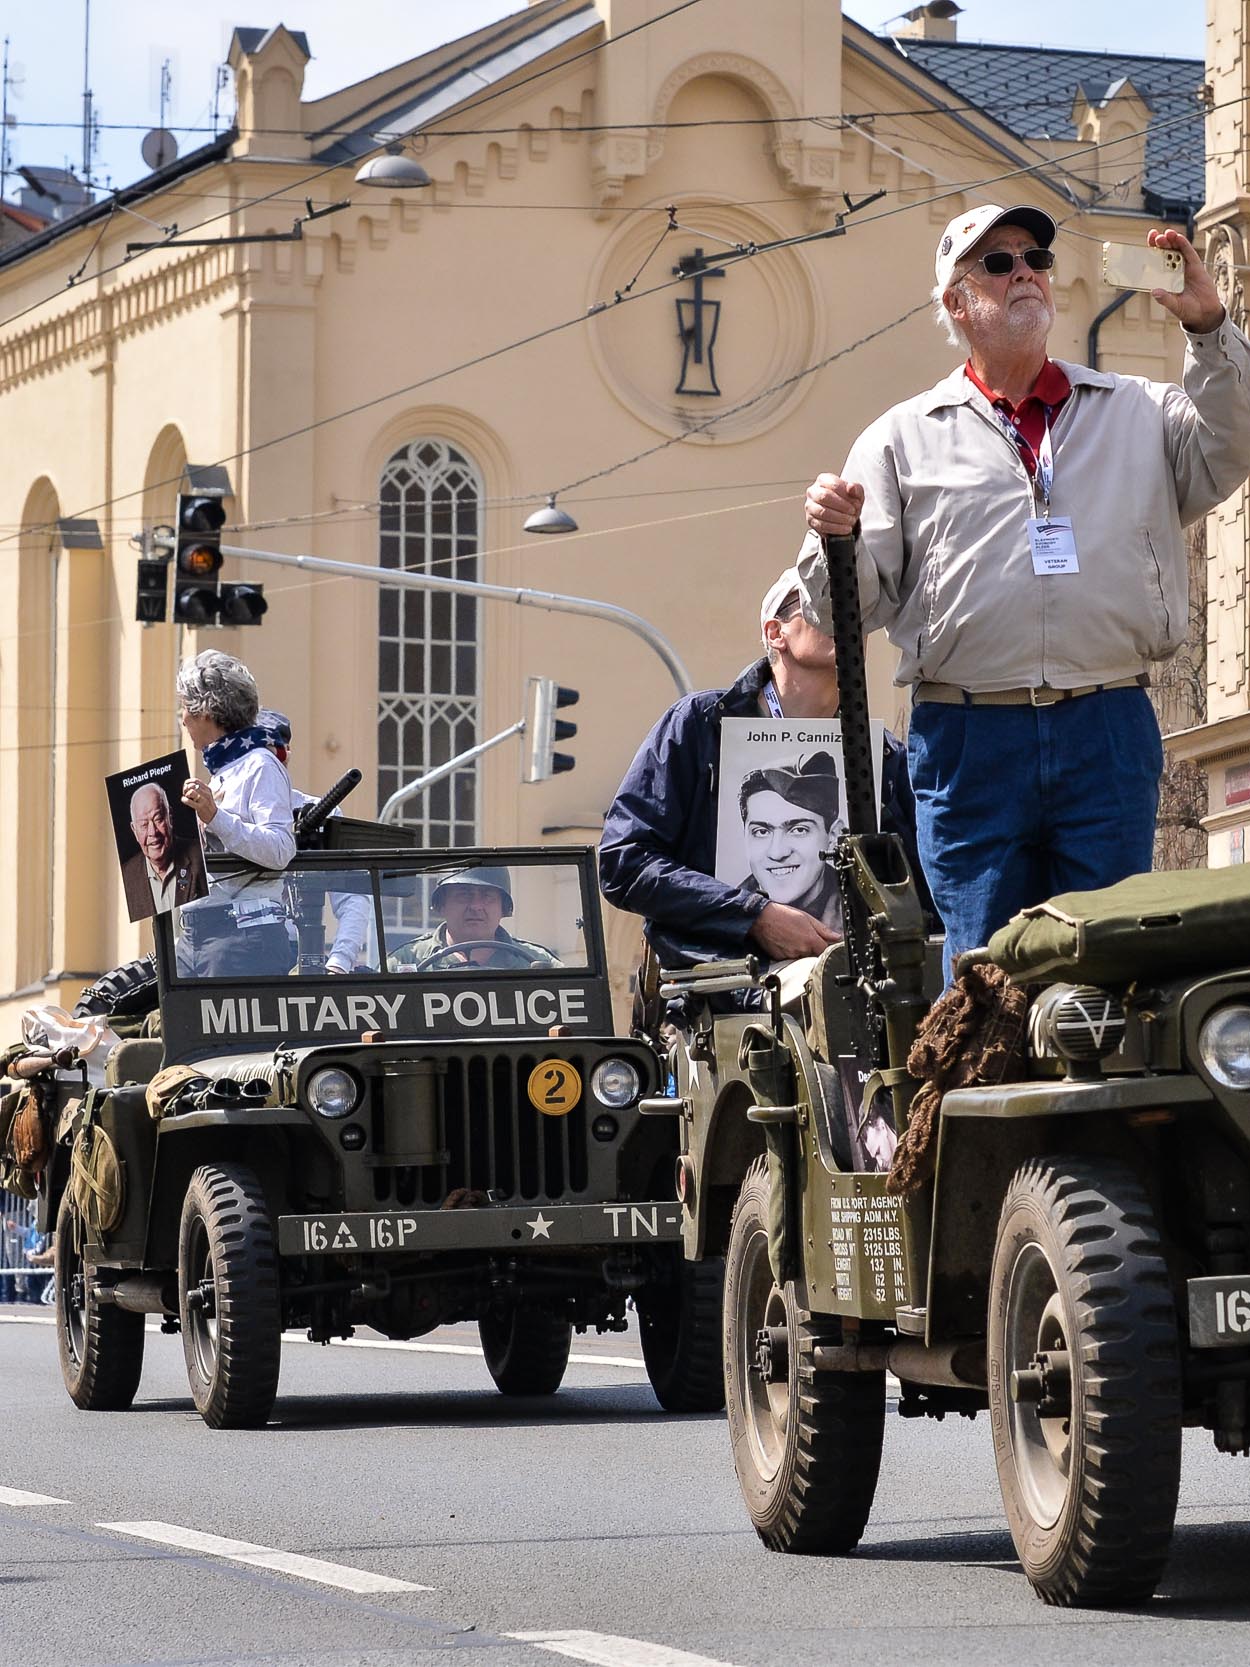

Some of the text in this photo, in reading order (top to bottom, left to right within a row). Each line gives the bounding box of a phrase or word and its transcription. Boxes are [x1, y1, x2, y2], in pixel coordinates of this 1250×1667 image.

[746, 731, 777, 742] John
[781, 731, 793, 742] P.
[122, 763, 172, 788] Richard Pieper
[201, 989, 589, 1034] MILITARY POLICE
[544, 1069, 567, 1104] 2
[830, 1197, 842, 1209] FROM
[871, 1195, 903, 1209] AGENCY
[303, 1206, 685, 1251] 16 16P TN-
[832, 1227, 845, 1241] ROAD
[863, 1227, 883, 1241] 2315
[883, 1226, 903, 1241] LBS.
[833, 1242, 848, 1256] GROSS
[864, 1242, 883, 1256] 3125
[884, 1242, 904, 1256] LBS.
[870, 1257, 885, 1272] 132
[893, 1257, 905, 1271] IN.
[875, 1273, 886, 1287] 62
[893, 1272, 906, 1286] IN.
[876, 1288, 887, 1302] 52
[894, 1287, 907, 1302] IN.
